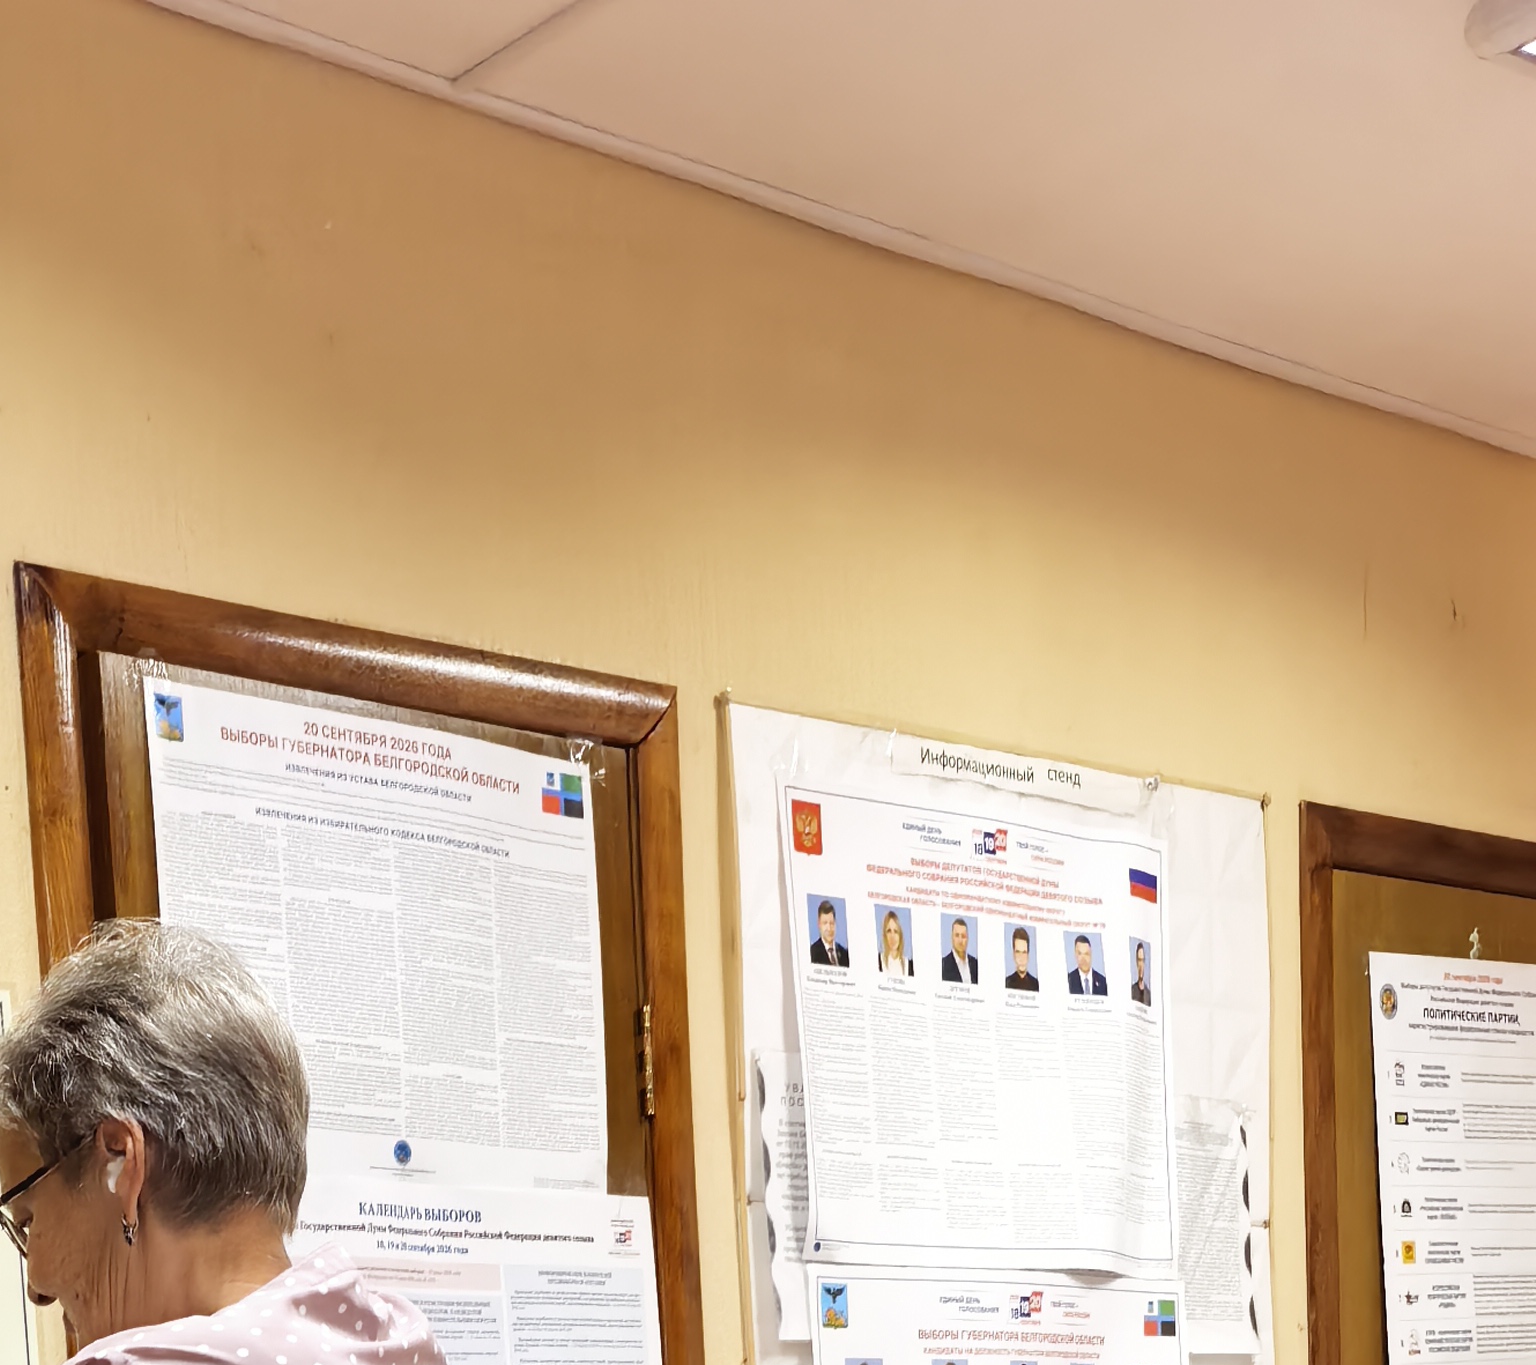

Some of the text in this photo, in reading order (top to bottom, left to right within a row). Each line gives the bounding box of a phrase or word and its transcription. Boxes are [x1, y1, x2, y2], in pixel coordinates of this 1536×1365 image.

[304, 721, 452, 761] 20 СЕНТЯБРЯ 2026 ГОДА
[220, 726, 520, 795] ВЫБОРЫ ГУБЕРНАТОРА БЕЛГОРОДСКОЙ ОБЛАСТИ
[920, 746, 1081, 789] Информационный стенд
[1423, 1007, 1486, 1022] ПОЛИТИЧЕСКИЕ
[359, 1202, 482, 1224] КАЛЕНДАРЬ ВЫБОРОВ
[918, 1329, 958, 1340] ВЫБОРЫ
[961, 1329, 1019, 1342] ГУБЕРНАТОРА
